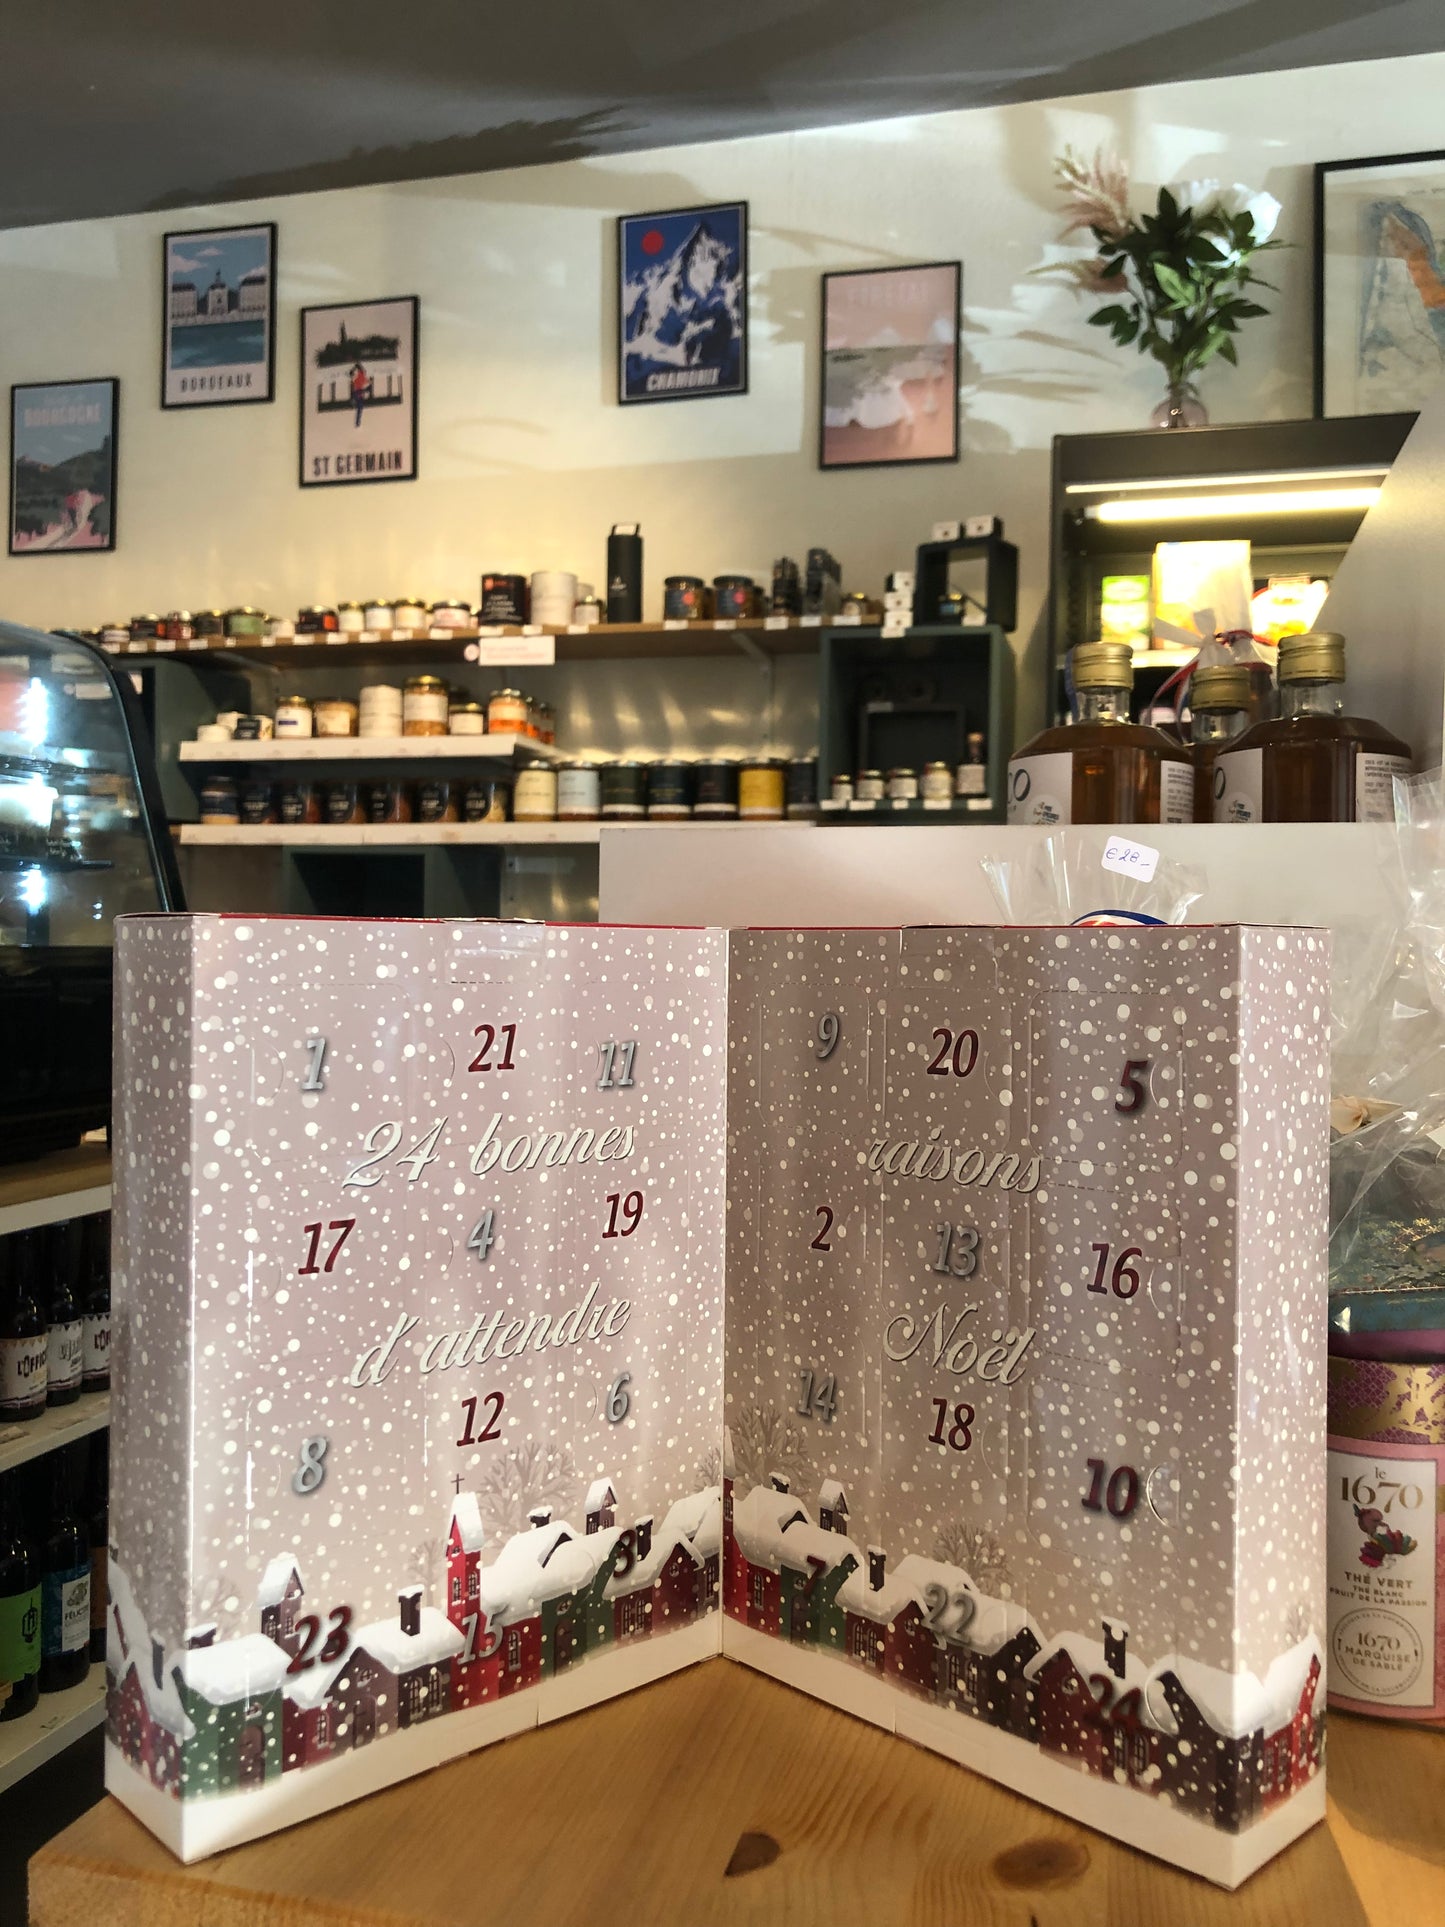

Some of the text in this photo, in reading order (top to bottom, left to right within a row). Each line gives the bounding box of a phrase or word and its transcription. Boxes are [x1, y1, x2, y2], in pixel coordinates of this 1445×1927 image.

[180, 373, 252, 392] BORDEAUX
[313, 450, 402, 475] ST GERMAIN
[468, 1023, 516, 1073] 21
[817, 1014, 839, 1059] 9
[927, 1028, 979, 1077] 20
[301, 1038, 326, 1091] 1
[598, 1041, 635, 1087] 11
[1115, 1060, 1149, 1112] 5
[342, 1112, 634, 1189] 24 bonnes
[868, 1127, 1041, 1193] raisons
[467, 1209, 494, 1260] 4
[602, 1190, 644, 1239] 19
[811, 1206, 834, 1251] 2
[298, 1218, 356, 1275] 17
[933, 1223, 980, 1276] 13
[1086, 1243, 1143, 1299] 16
[883, 1302, 1036, 1385] Noël
[456, 1391, 505, 1447] 12
[607, 1373, 631, 1422] 6
[797, 1370, 836, 1420] 14
[928, 1397, 975, 1451] 18
[292, 1436, 328, 1493] 8
[1081, 1458, 1139, 1517] 10
[1342, 1475, 1423, 1514] 1670
[614, 1529, 638, 1579] 3
[807, 1555, 826, 1599] 7
[1329, 1587, 1428, 1607] FRUIT DE LA PASSION
[1374, 1588, 1404, 1598] BLANC
[1377, 1577, 1414, 1589] VERT
[456, 1604, 509, 1664] 15
[921, 1582, 977, 1645] 22
[287, 1606, 352, 1674] 23
[1345, 1645, 1411, 1664] MARQUISE
[1353, 1656, 1366, 1667] DE
[1358, 1632, 1401, 1653] 1670
[1083, 1673, 1142, 1738] 24
